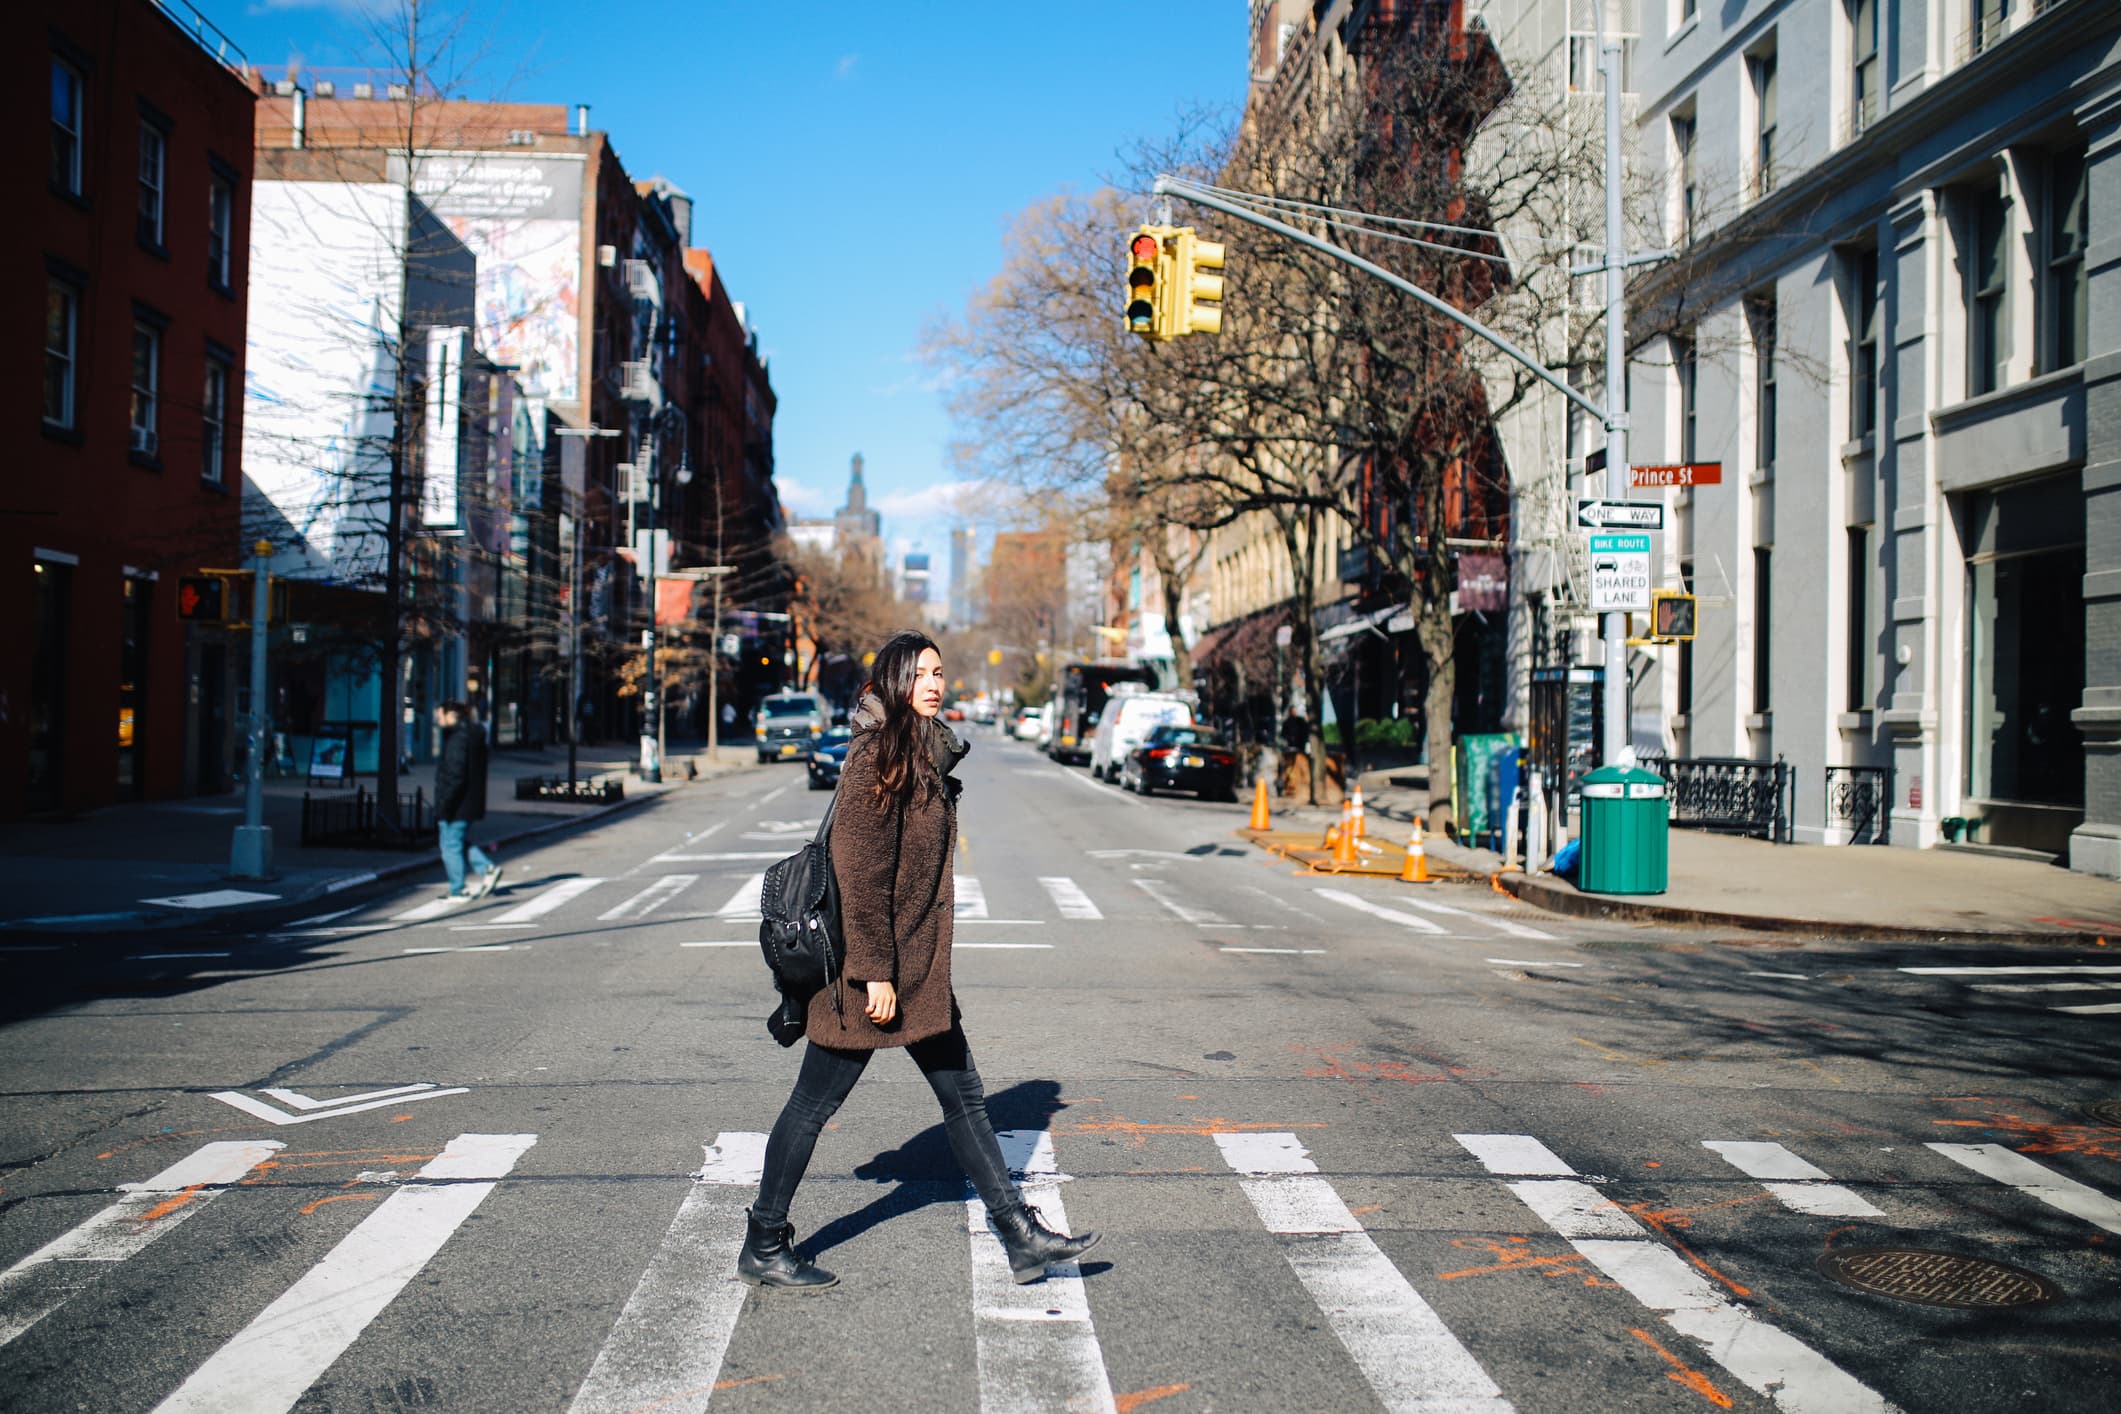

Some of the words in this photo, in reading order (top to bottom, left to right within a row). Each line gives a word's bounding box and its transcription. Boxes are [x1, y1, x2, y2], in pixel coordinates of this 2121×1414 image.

[1632, 468, 1674, 485] Prince
[1679, 467, 1693, 483] St
[1587, 508, 1615, 519] ONE
[1630, 509, 1657, 520] WAY
[1594, 539, 1613, 549] BIKE
[1617, 539, 1646, 549] ROUTE
[1595, 576, 1646, 588] SHARED
[1604, 592, 1637, 603] LANE
